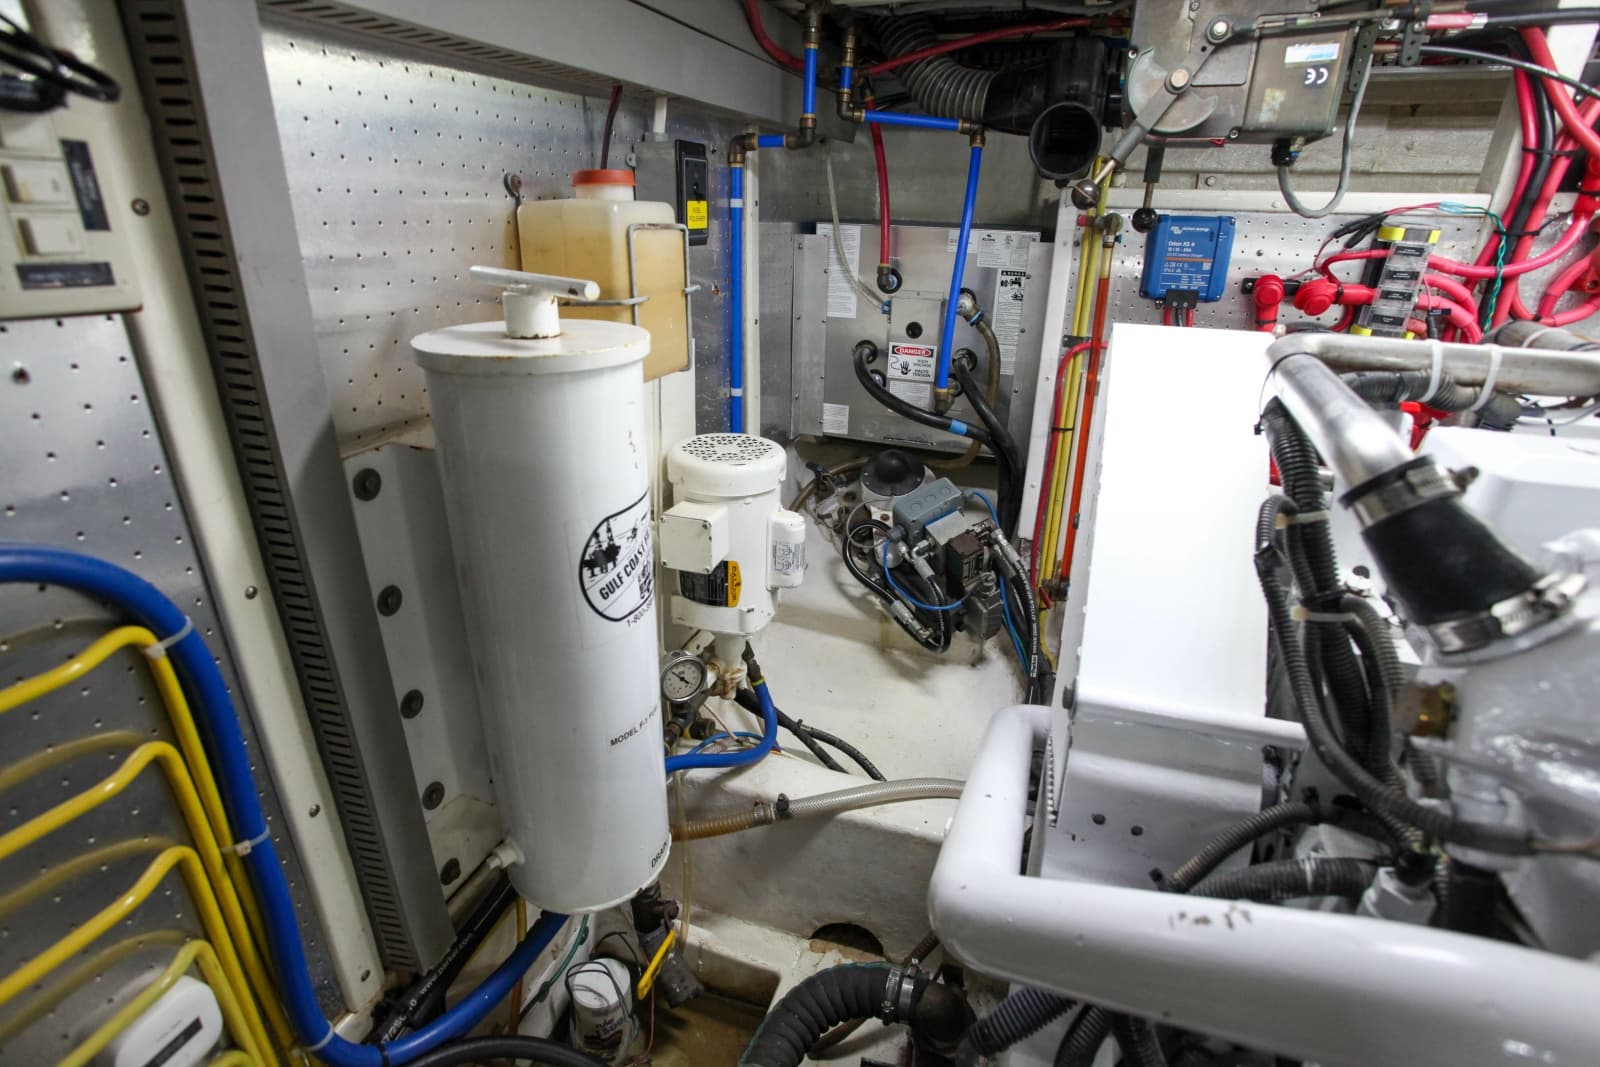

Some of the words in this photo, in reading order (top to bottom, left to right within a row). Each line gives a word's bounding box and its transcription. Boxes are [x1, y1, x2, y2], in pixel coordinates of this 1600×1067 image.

[900, 346, 926, 355] DANGER
[599, 573, 625, 600] GULF
[623, 547, 646, 577] COAST
[610, 726, 638, 746] MODEL
